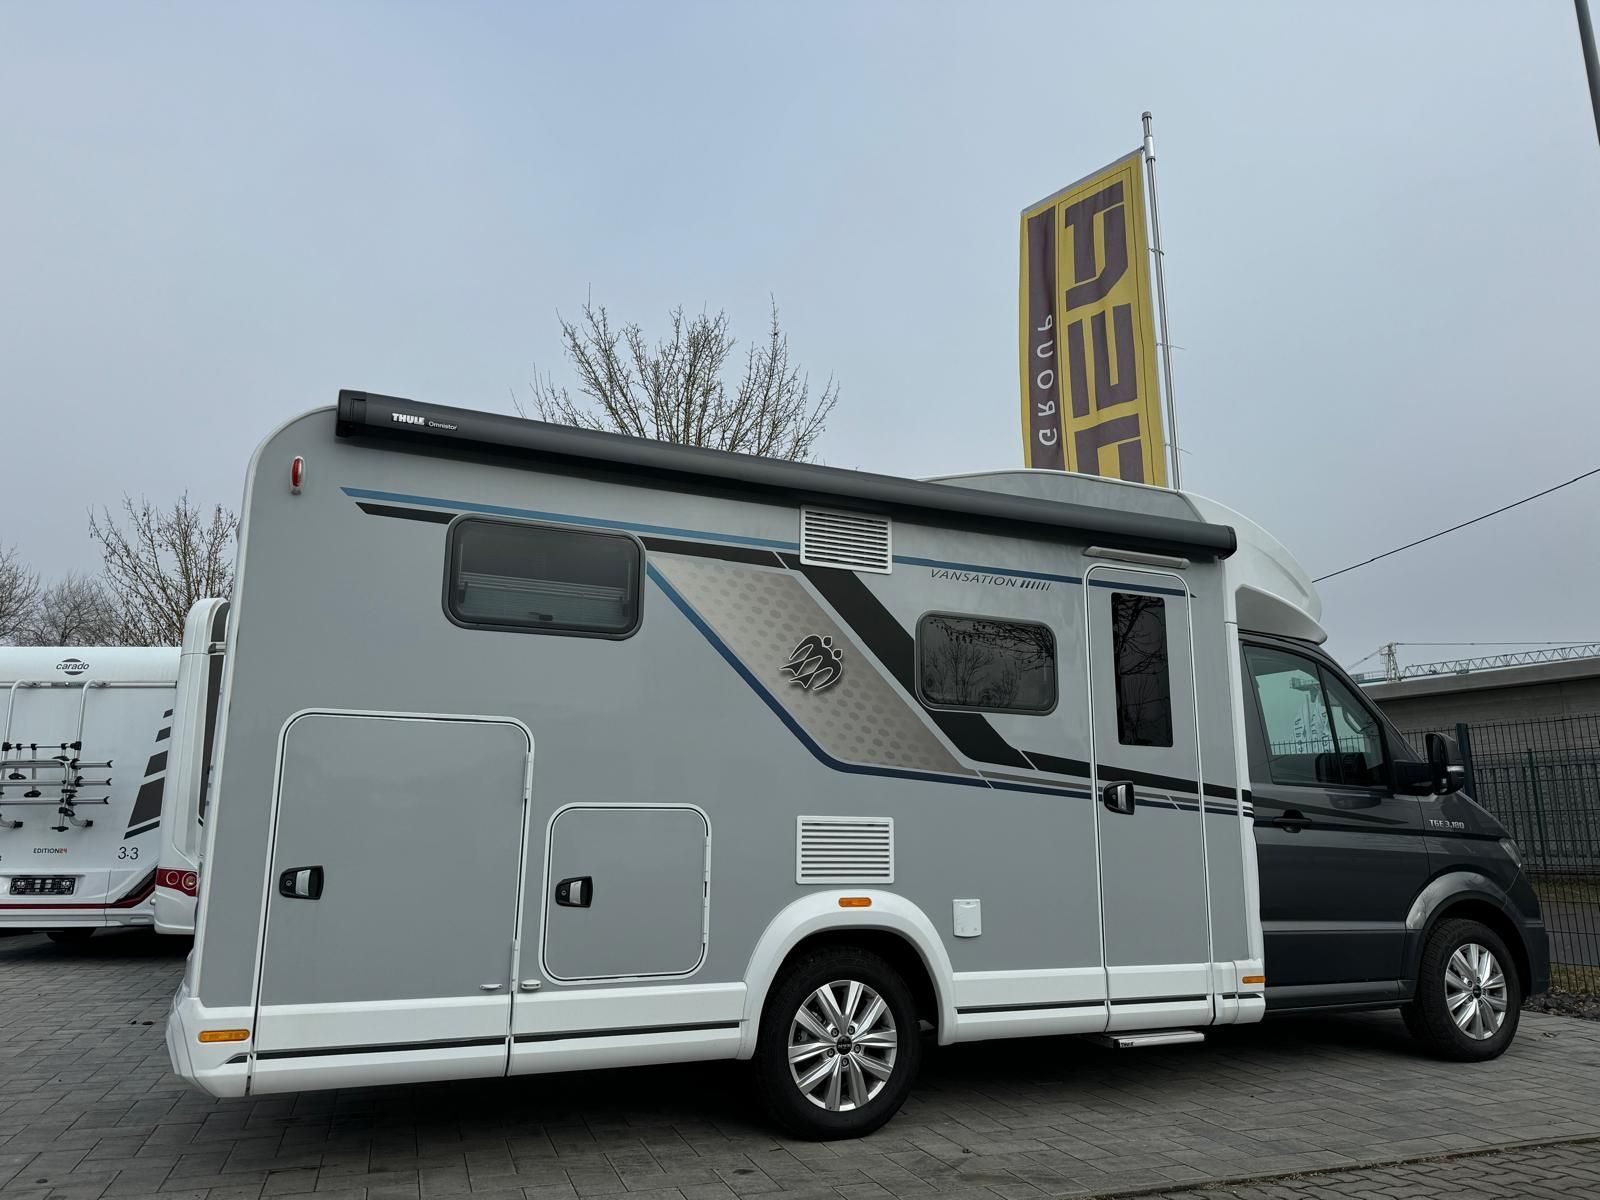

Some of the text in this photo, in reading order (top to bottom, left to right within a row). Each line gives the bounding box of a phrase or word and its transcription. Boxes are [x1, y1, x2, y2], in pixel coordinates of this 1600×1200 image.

[391, 412, 458, 431] THULE Omnistor
[930, 568, 1018, 588] VANSATION
[56, 662, 90, 670] carado
